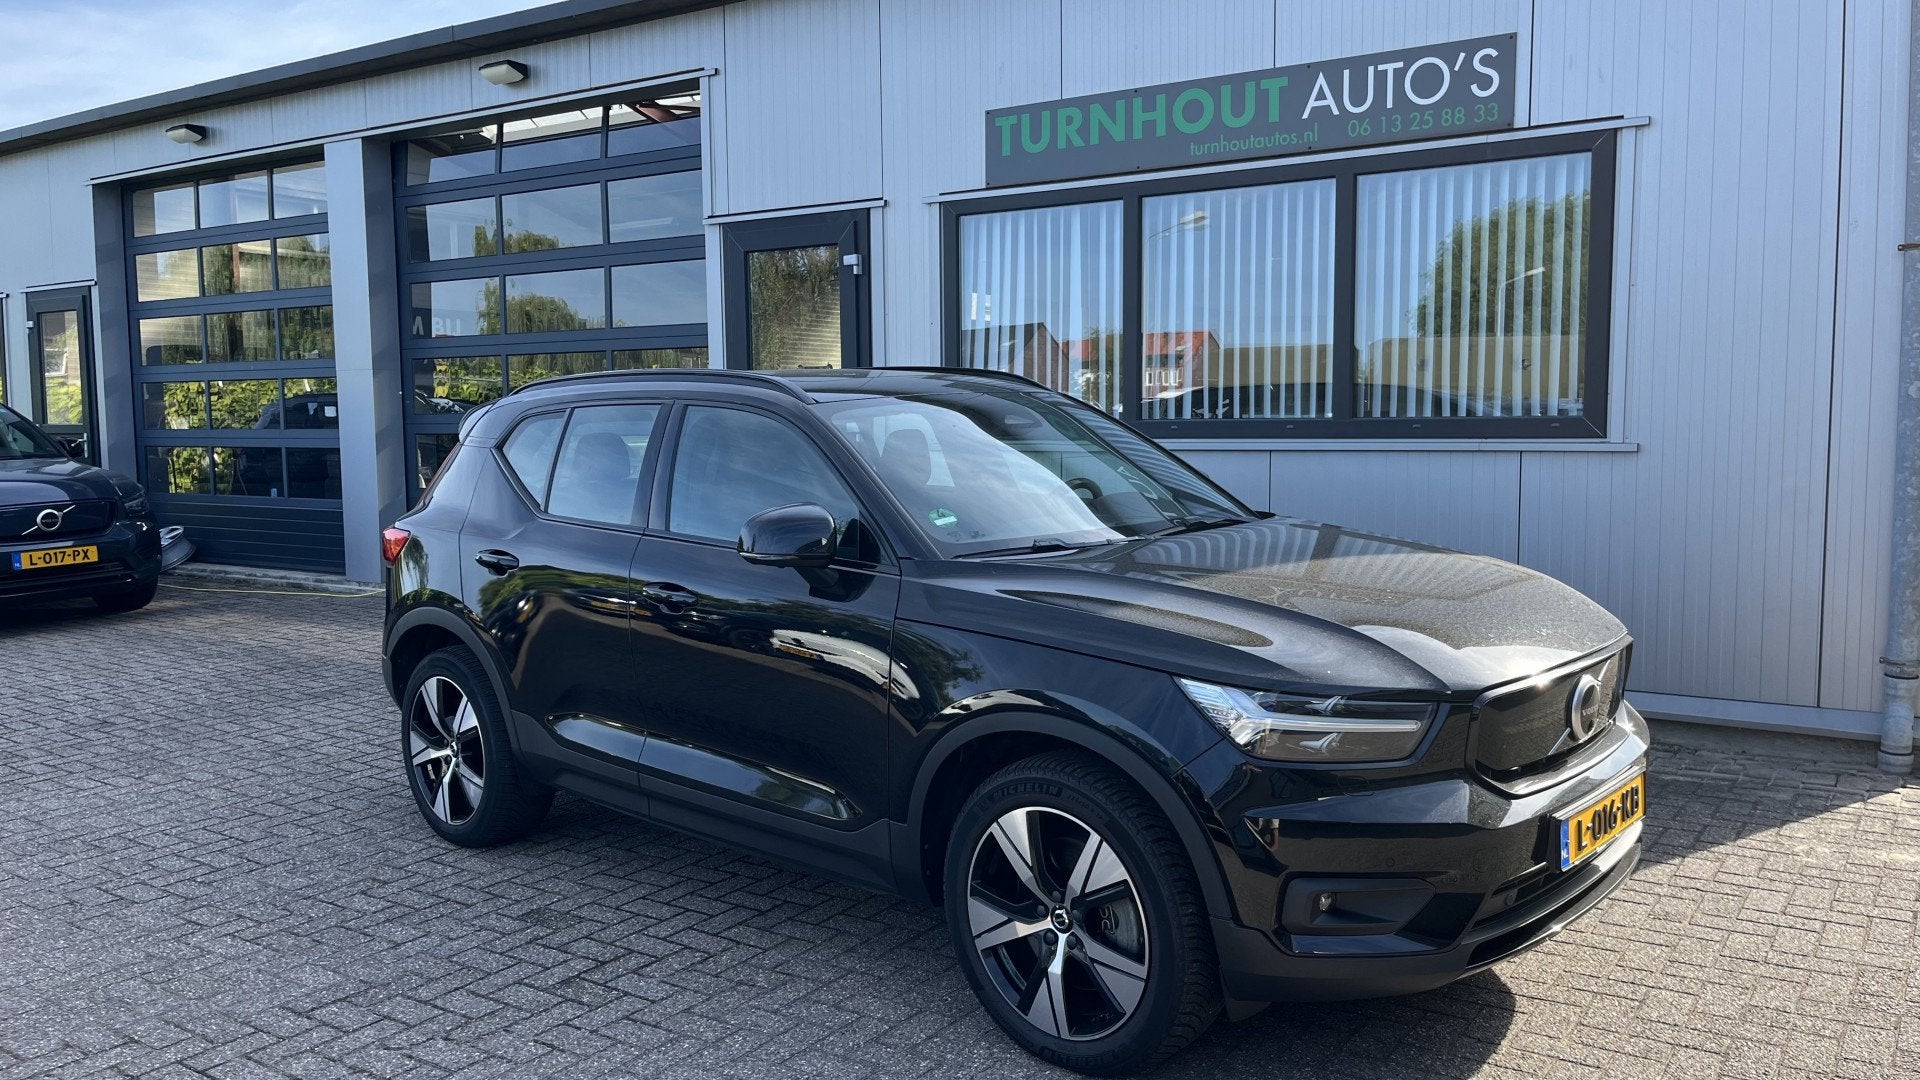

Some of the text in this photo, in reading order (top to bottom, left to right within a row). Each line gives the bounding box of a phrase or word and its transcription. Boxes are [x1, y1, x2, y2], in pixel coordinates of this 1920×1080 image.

[995, 47, 1500, 157] TURNHOUT AUTO'S
[1347, 102, 1499, 138] 06 13 25 88 33
[1189, 122, 1319, 156] turnhoutautos.nl
[29, 548, 91, 567] L-017-PX
[993, 781, 1059, 798] MICHELIN
[1561, 784, 1640, 859] NL L-016-KB
